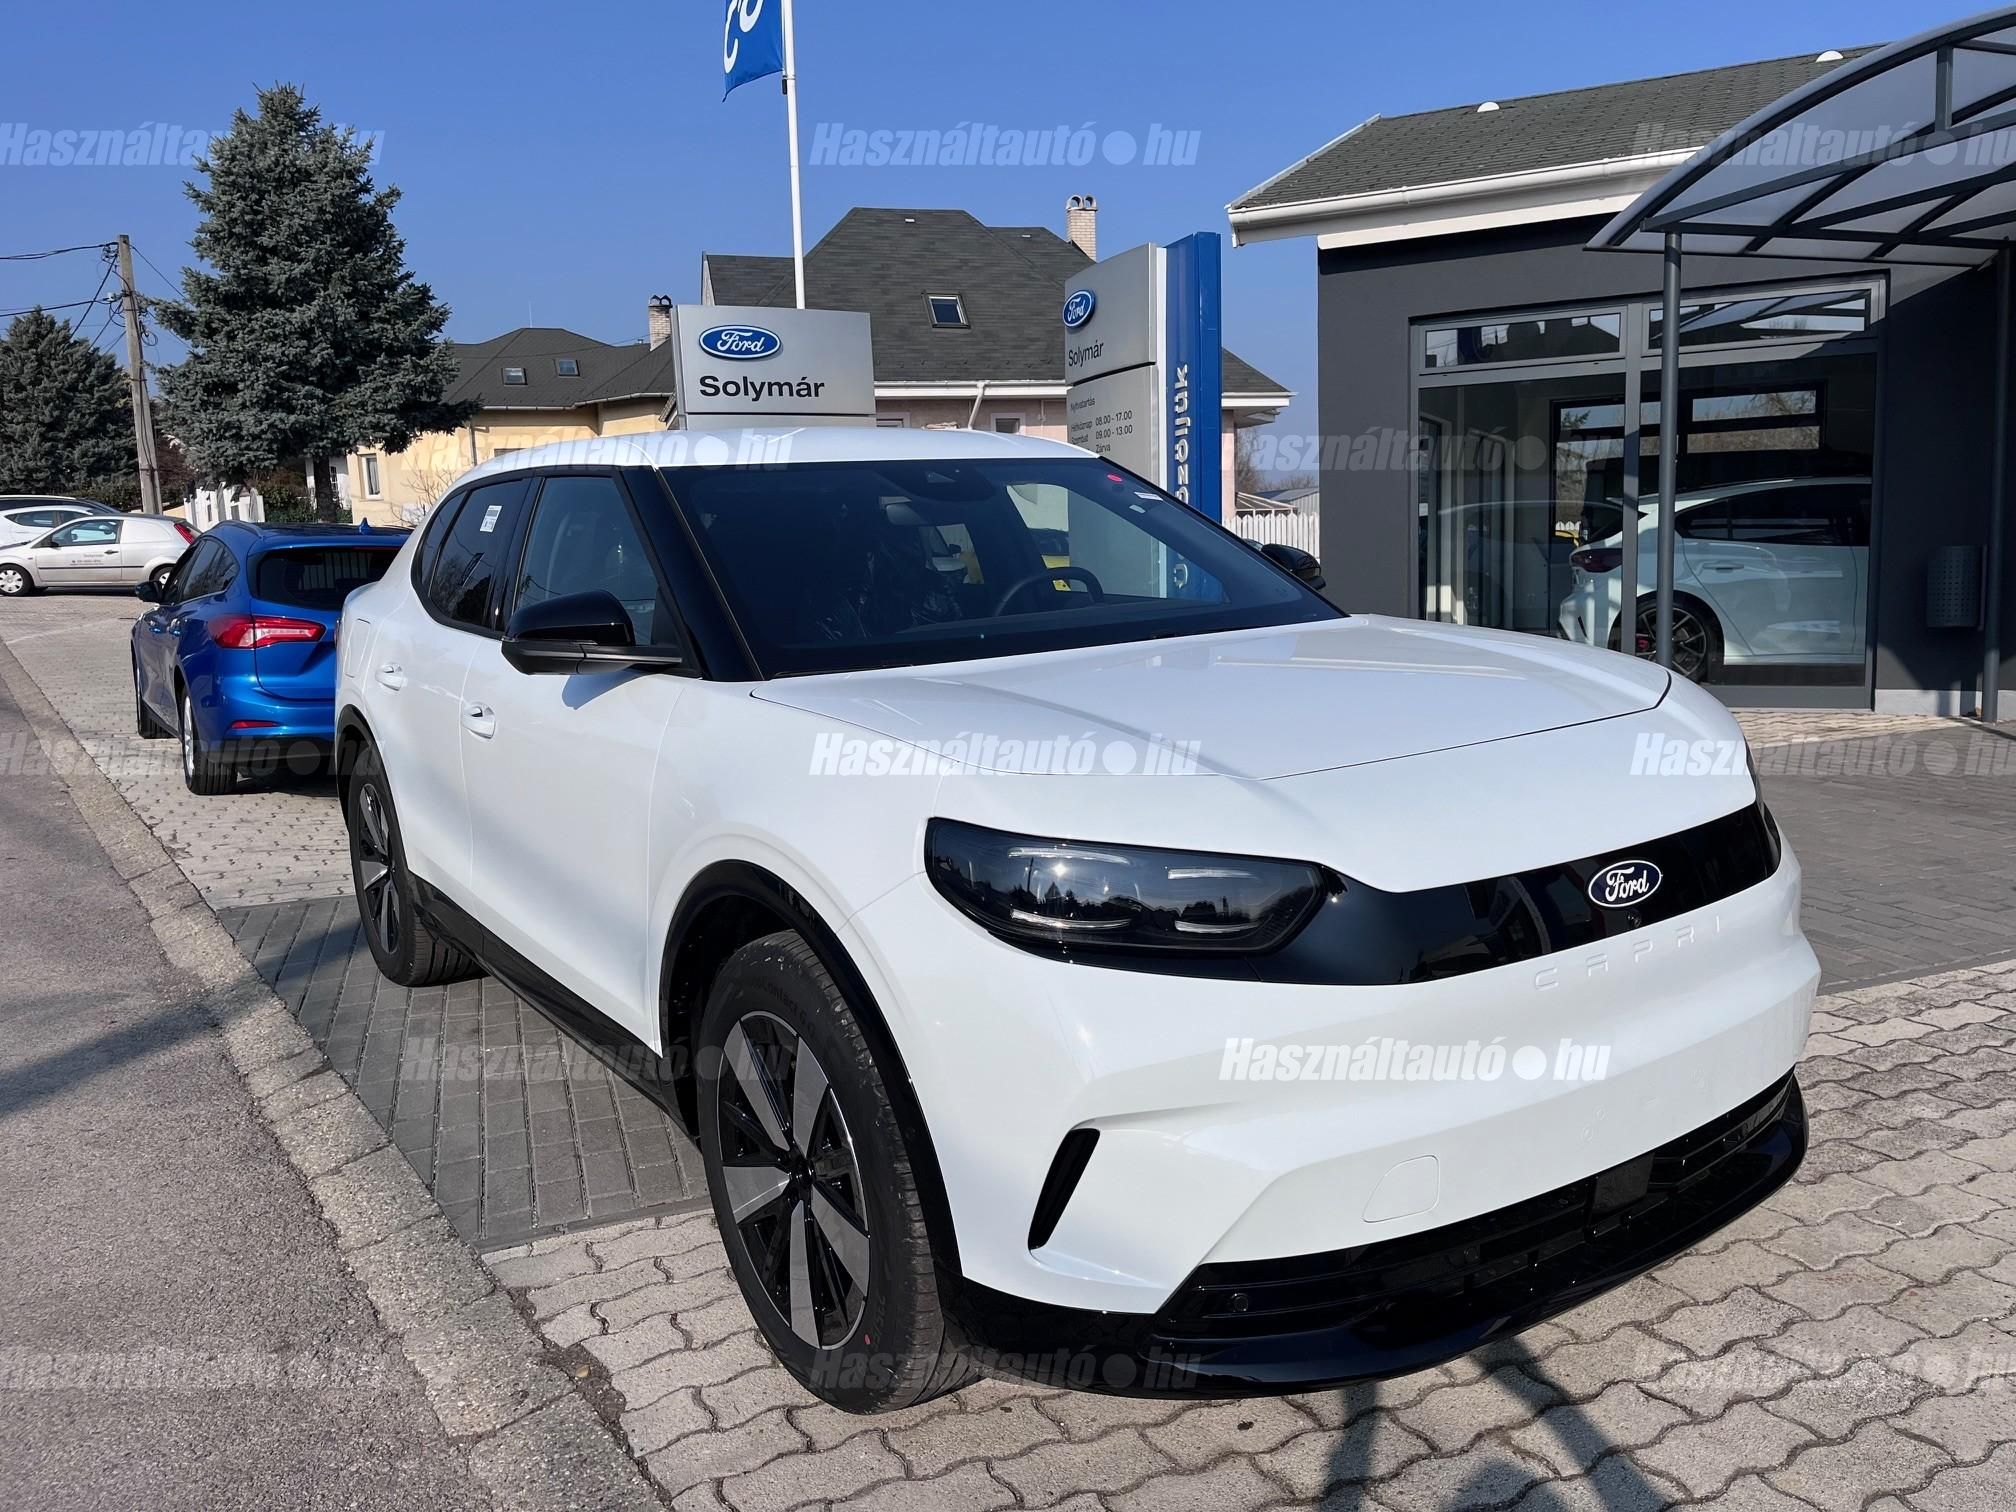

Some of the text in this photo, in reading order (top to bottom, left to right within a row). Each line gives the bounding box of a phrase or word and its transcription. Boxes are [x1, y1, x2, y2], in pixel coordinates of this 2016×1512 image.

[1067, 296, 1087, 322] Ford
[715, 329, 766, 352] Ford
[1068, 340, 1104, 367] Solymár
[699, 375, 825, 402] Solymár
[1095, 414, 1111, 426] 08.00
[1115, 410, 1133, 422] 17.00
[1095, 428, 1111, 440] 09.00
[1115, 424, 1133, 436] 13.00
[1605, 866, 1650, 902] Ford
[1534, 915, 1721, 991] CAPRI
